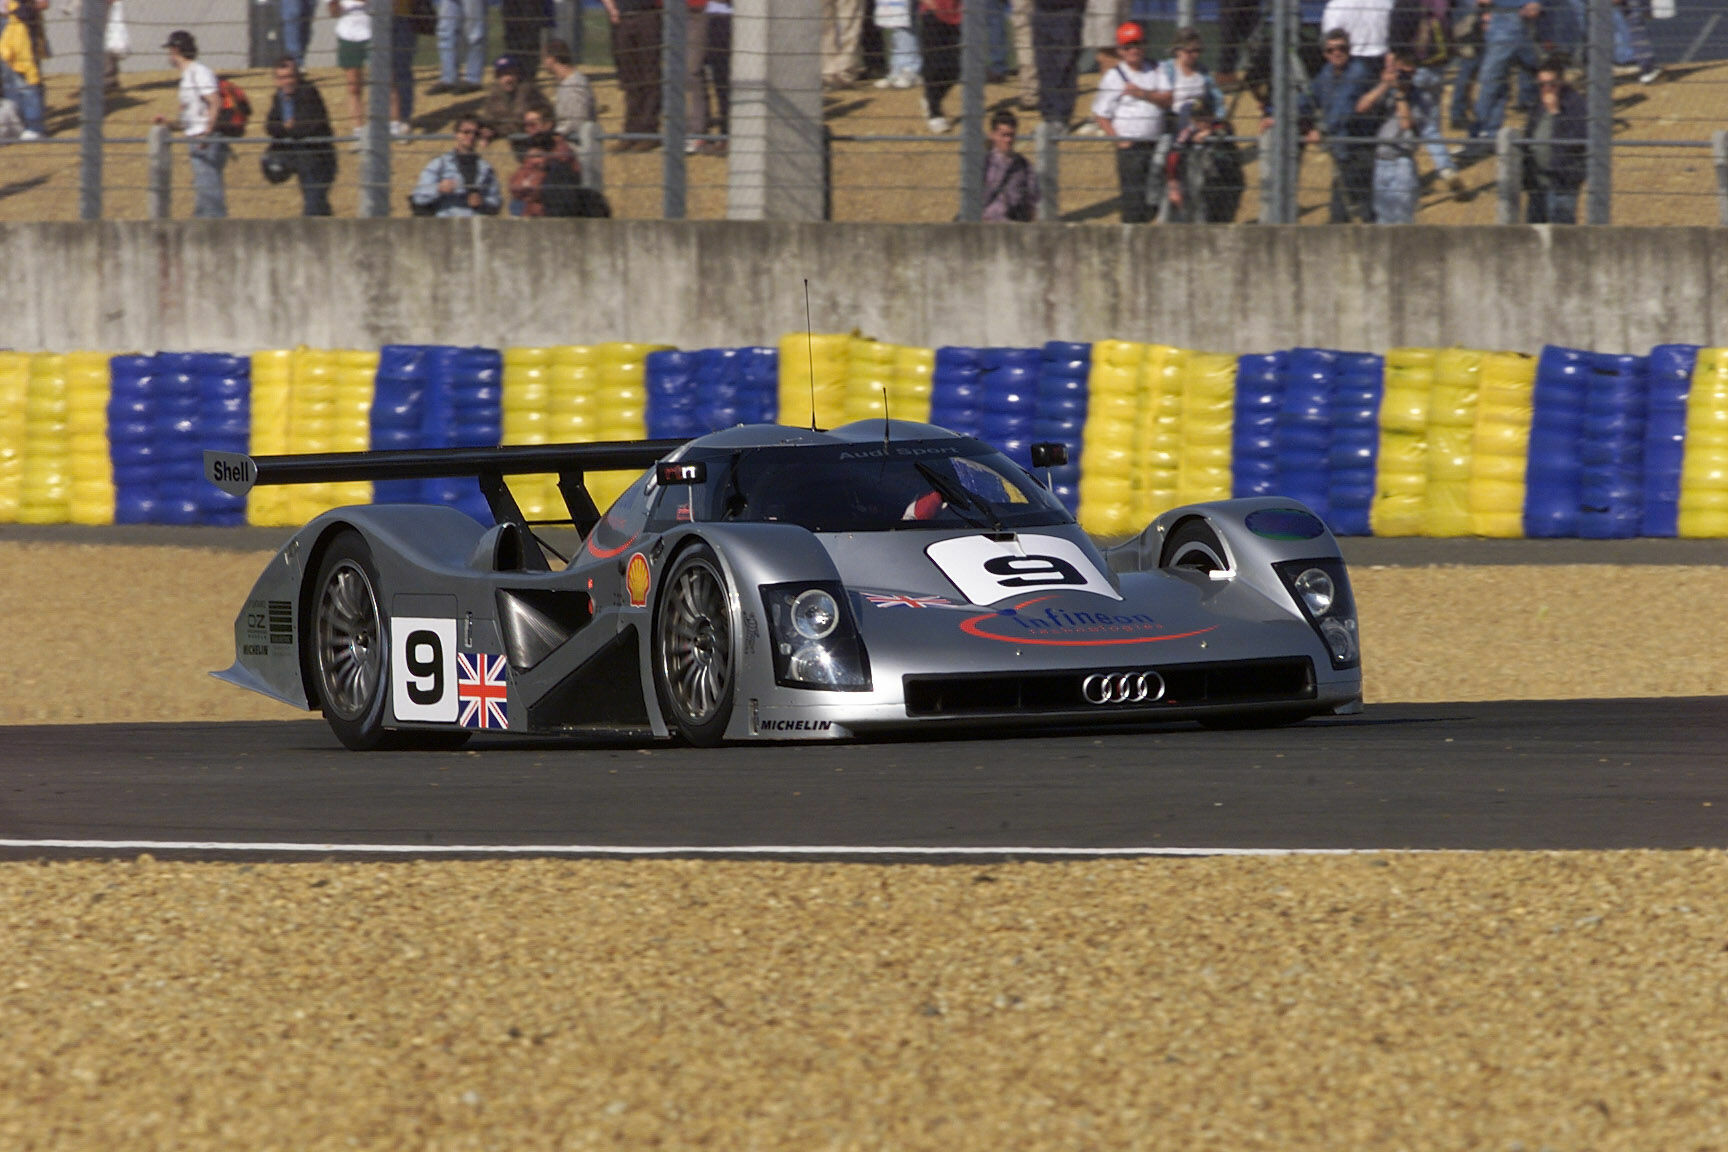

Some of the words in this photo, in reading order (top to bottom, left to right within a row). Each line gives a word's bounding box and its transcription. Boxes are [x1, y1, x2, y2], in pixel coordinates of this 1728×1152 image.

[896, 446, 960, 457] Sport
[213, 461, 249, 482] Shell
[983, 554, 1088, 588] 9
[406, 630, 444, 705] 9
[760, 720, 832, 730] MICHELIN
